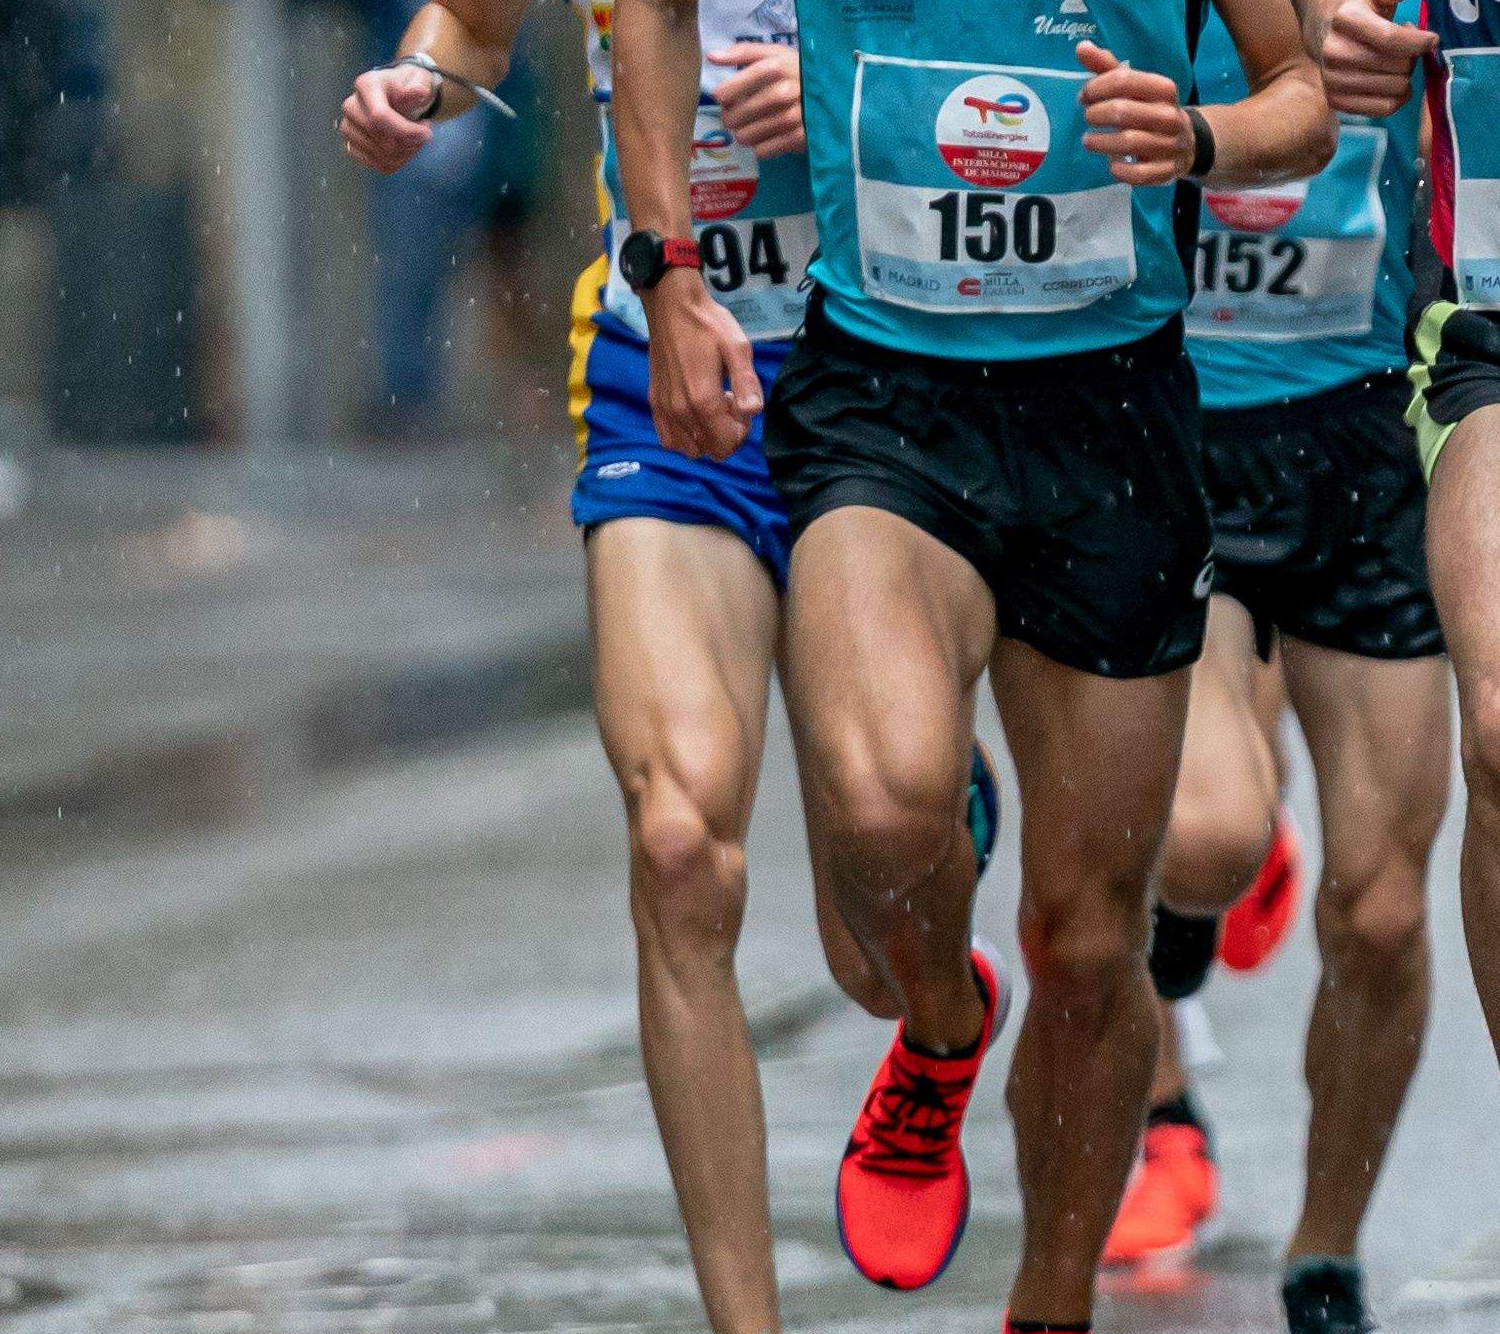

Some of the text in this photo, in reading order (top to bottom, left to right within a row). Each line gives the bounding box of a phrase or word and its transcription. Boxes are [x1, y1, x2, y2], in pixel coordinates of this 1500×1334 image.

[700, 219, 790, 293] 94
[928, 191, 1057, 264] 150
[1197, 233, 1307, 296] 152
